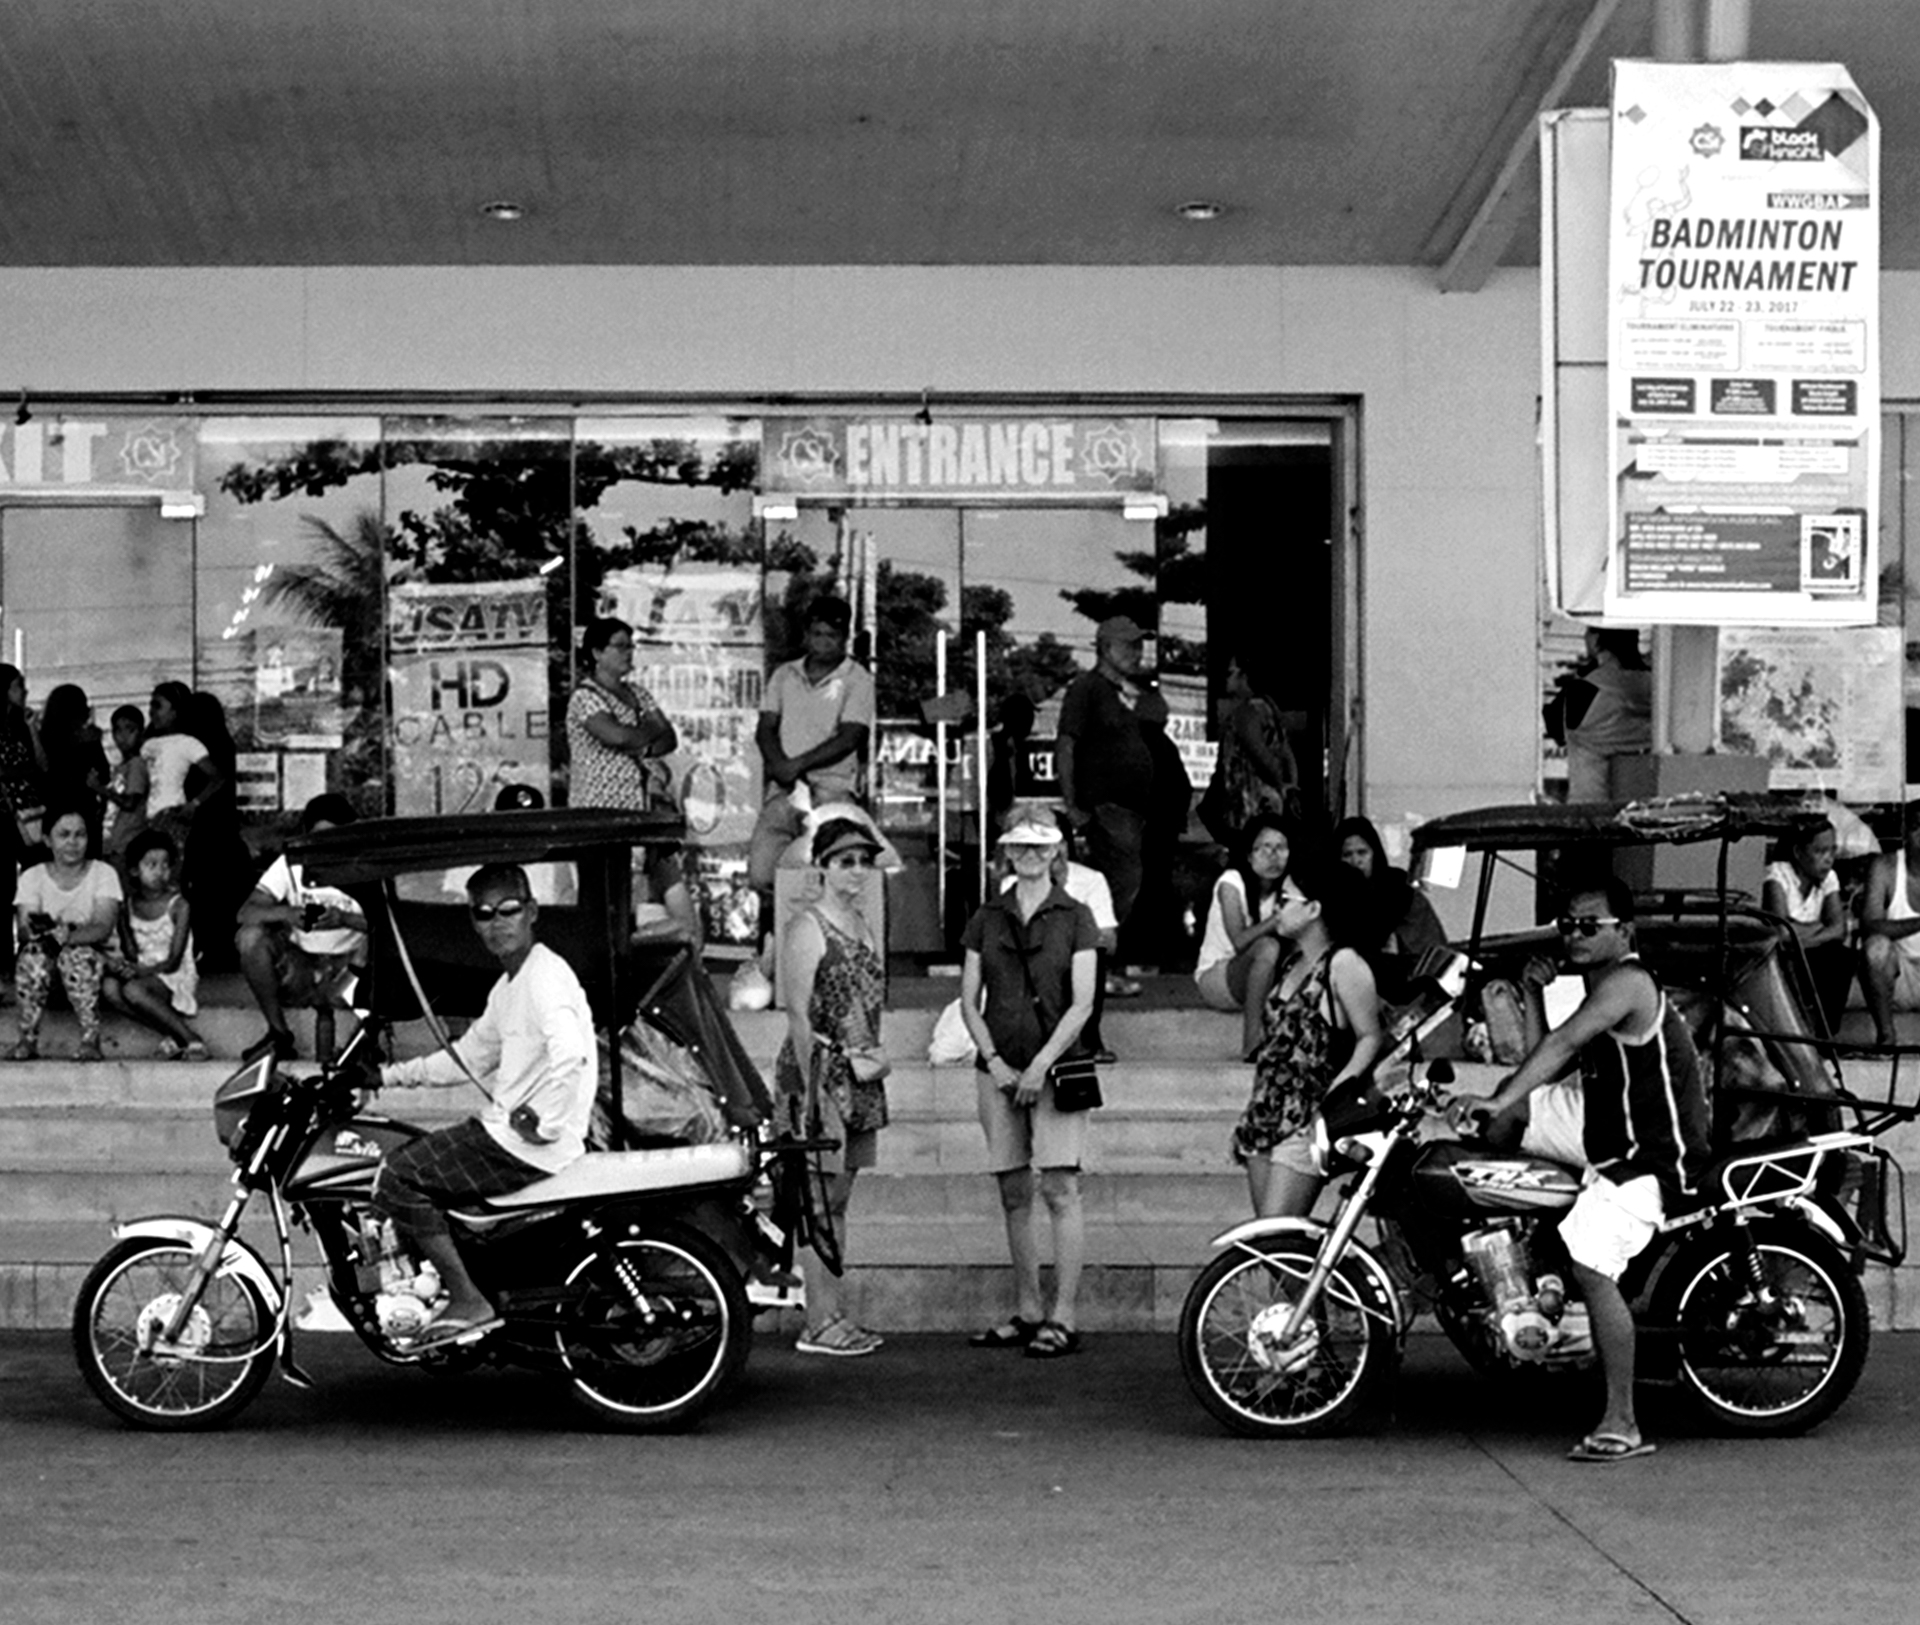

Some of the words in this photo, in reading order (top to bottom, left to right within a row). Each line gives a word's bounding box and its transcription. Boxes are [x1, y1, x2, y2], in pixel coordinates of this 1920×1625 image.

[1651, 217, 1843, 251] BADMINTON
[1639, 258, 1858, 292] TOURNAMENT
[1689, 301, 1716, 312] JULY
[1719, 301, 1734, 312] 22
[1768, 301, 1799, 313] 2017
[0, 422, 107, 482] IT
[847, 423, 1075, 485] ENTRANCE
[430, 660, 510, 710] HD
[395, 711, 549, 747] CABLE
